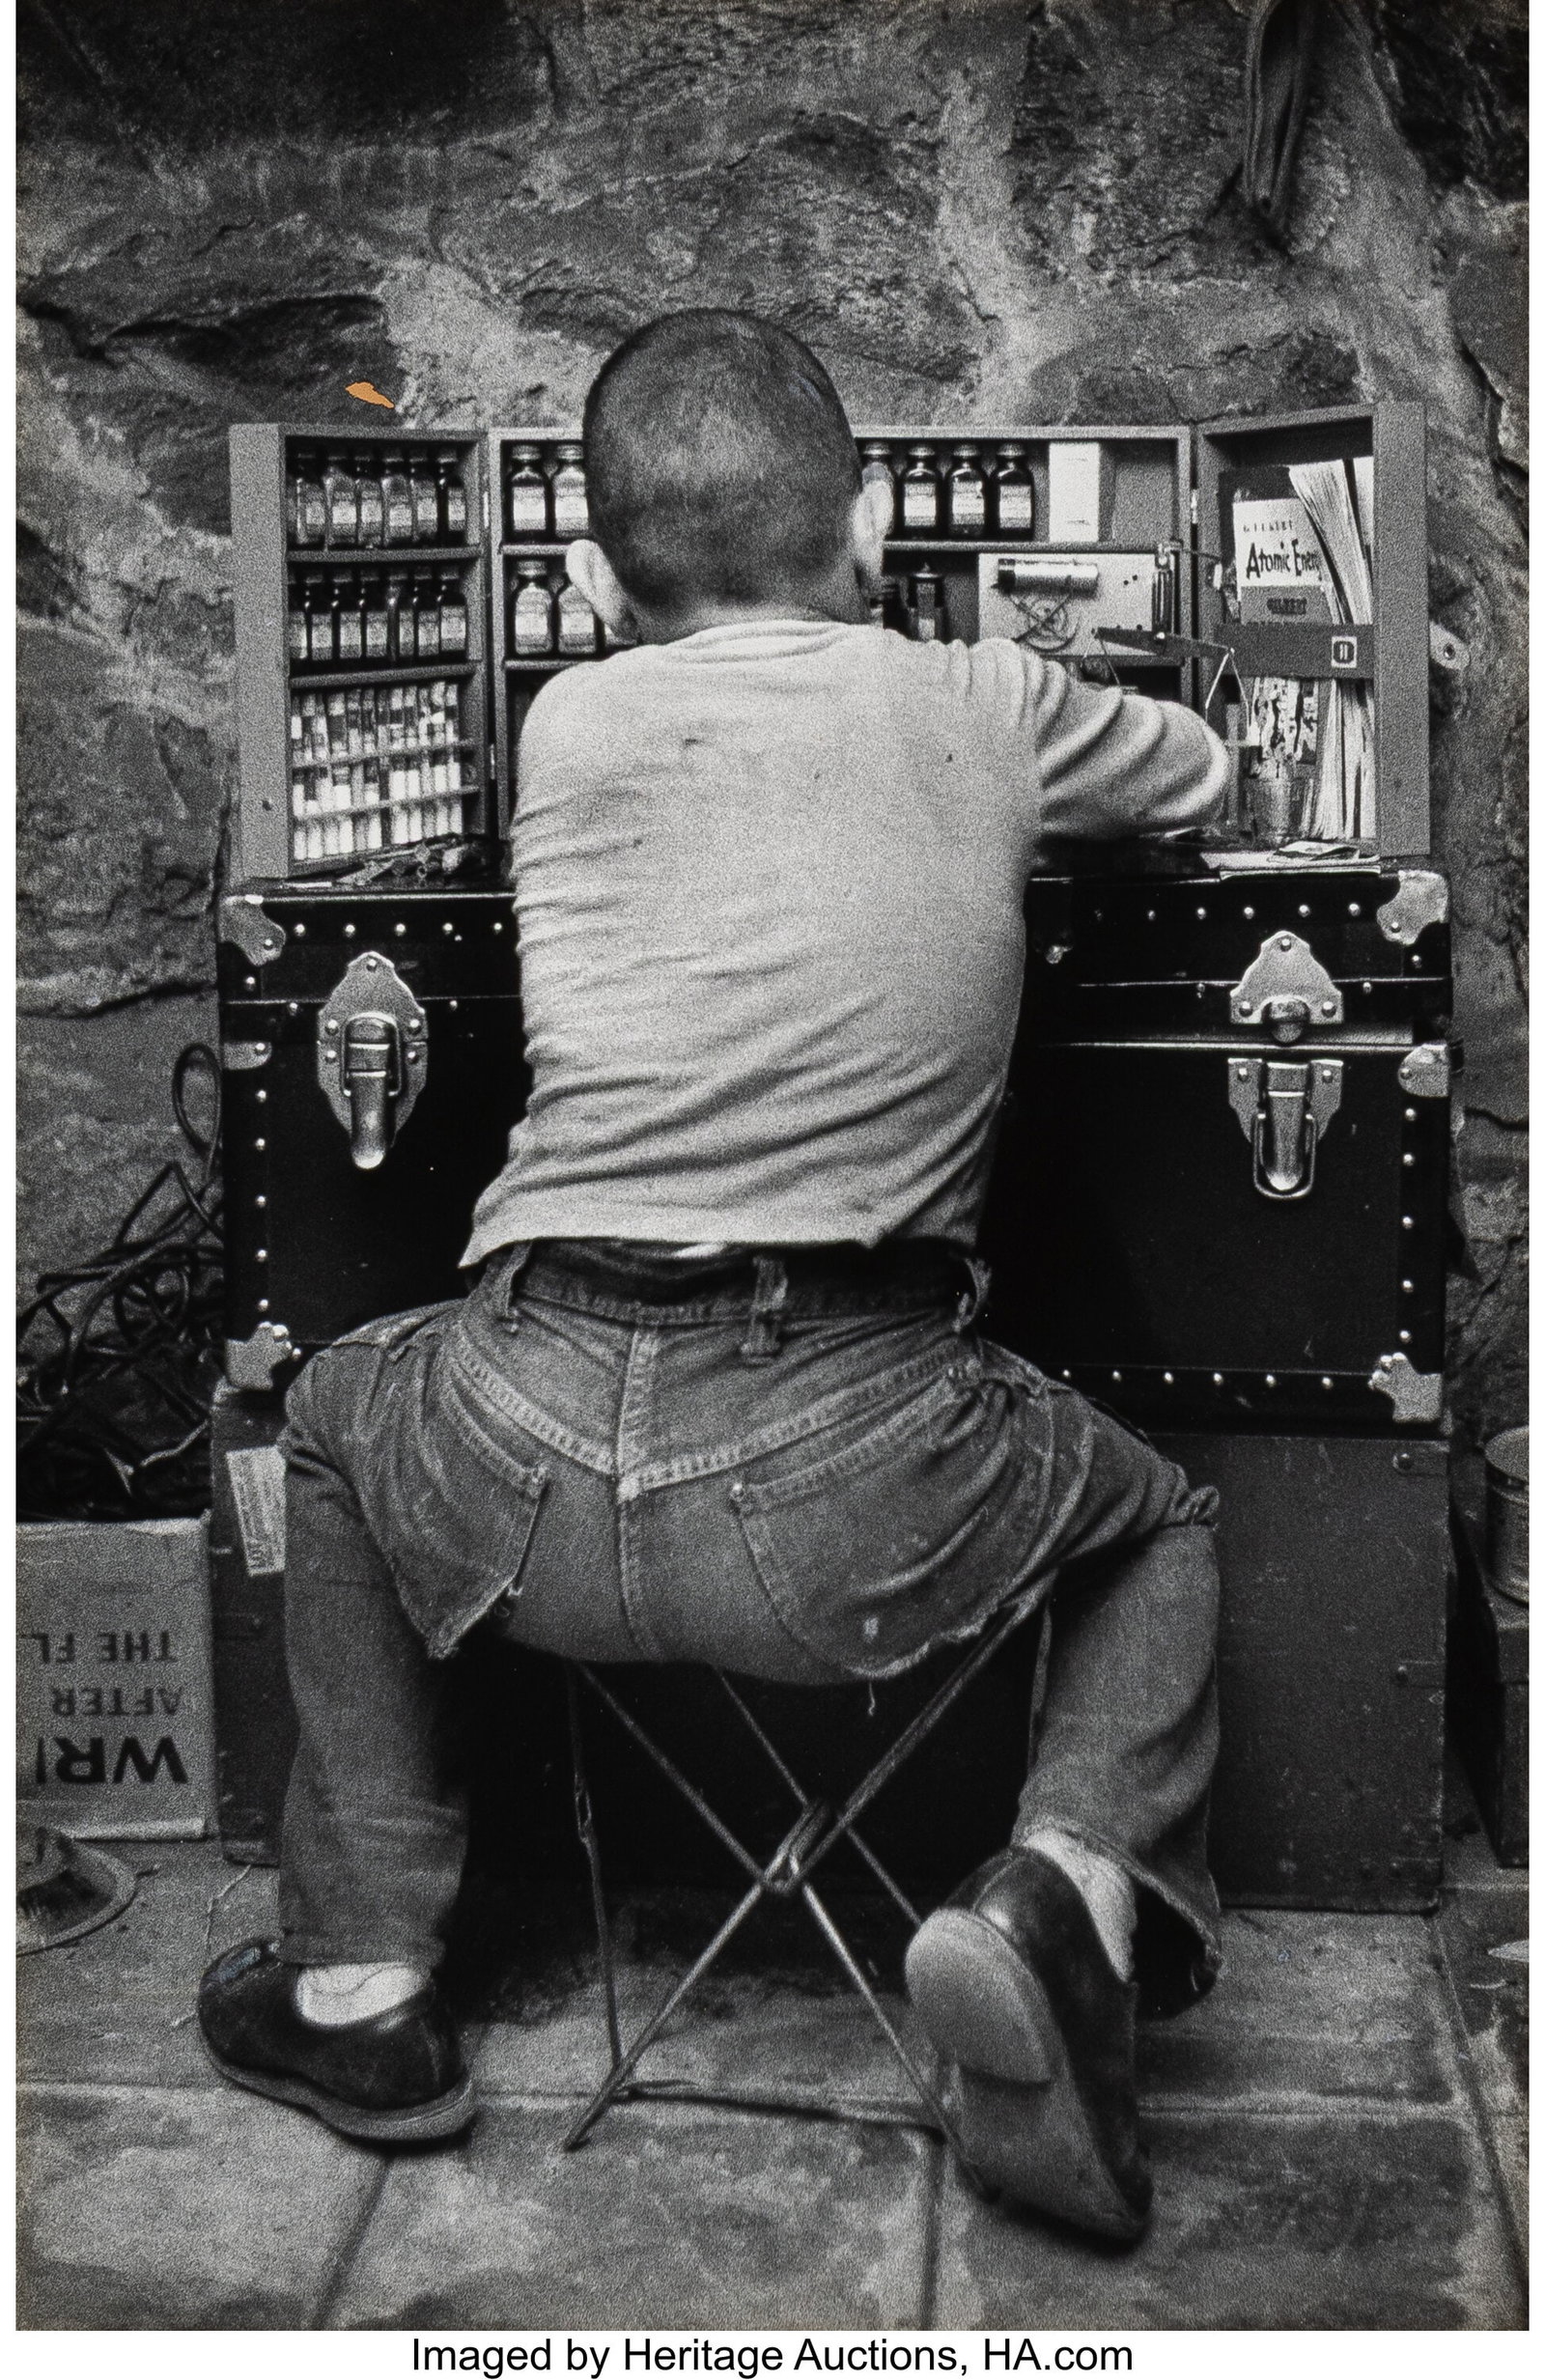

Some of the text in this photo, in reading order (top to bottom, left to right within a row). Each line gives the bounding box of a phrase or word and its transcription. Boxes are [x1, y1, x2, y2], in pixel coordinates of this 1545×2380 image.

[1246, 541, 1290, 579] Atomic
[98, 1632, 178, 1663] THE
[51, 1687, 183, 1717] AFTER
